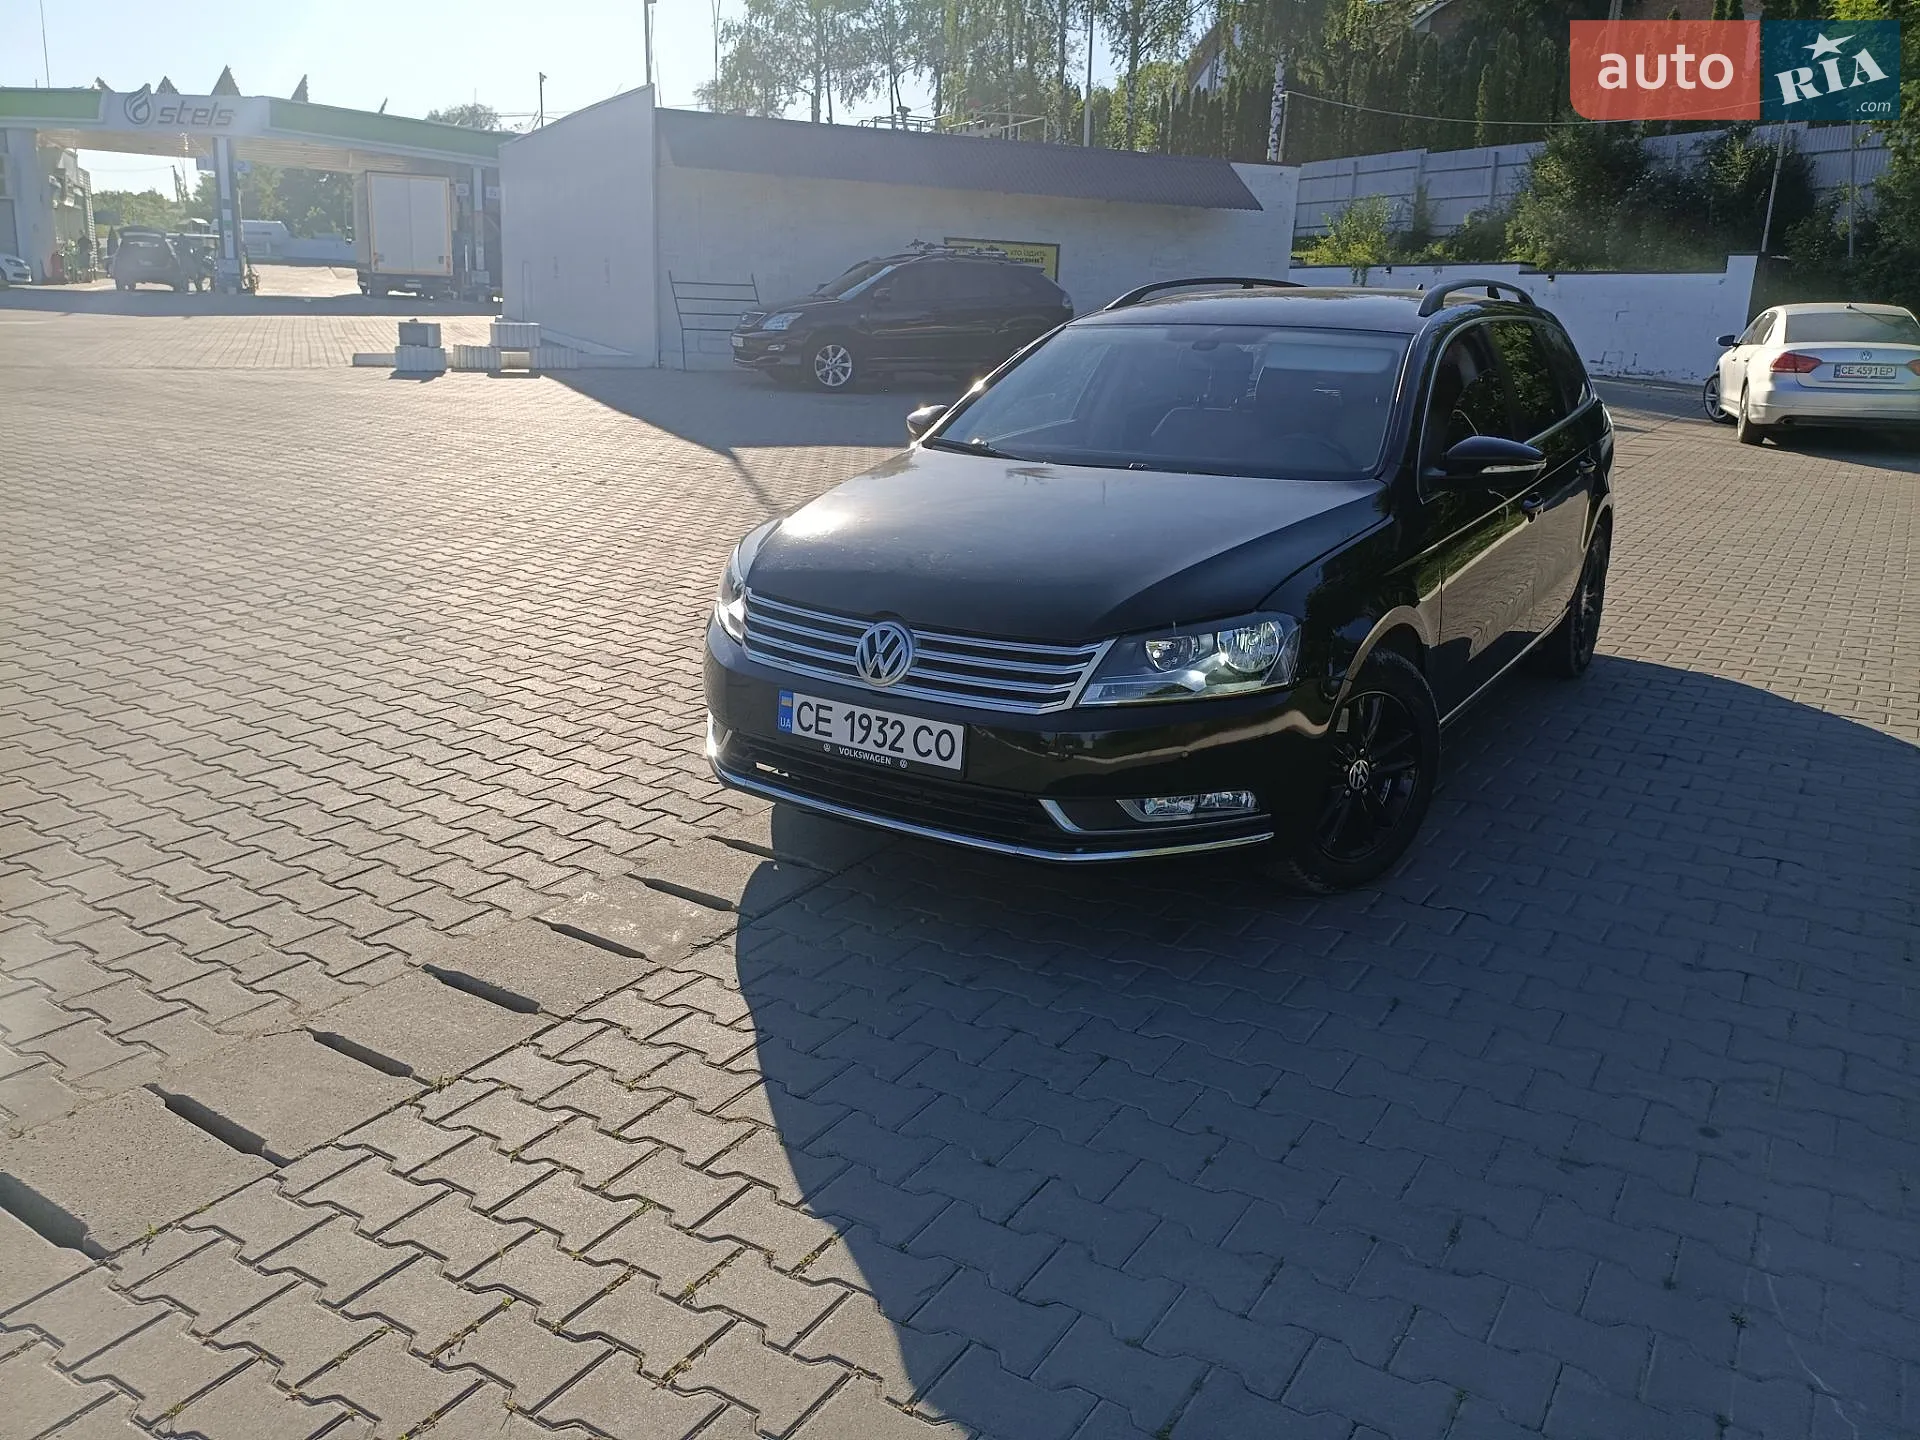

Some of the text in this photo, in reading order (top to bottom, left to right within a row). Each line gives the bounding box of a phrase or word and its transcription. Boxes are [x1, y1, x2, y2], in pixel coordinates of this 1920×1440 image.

[157, 100, 235, 127] stels
[780, 716, 792, 729] UA
[796, 701, 956, 762] CE 1932 CO
[838, 745, 892, 766] VOLKSWAGEN
